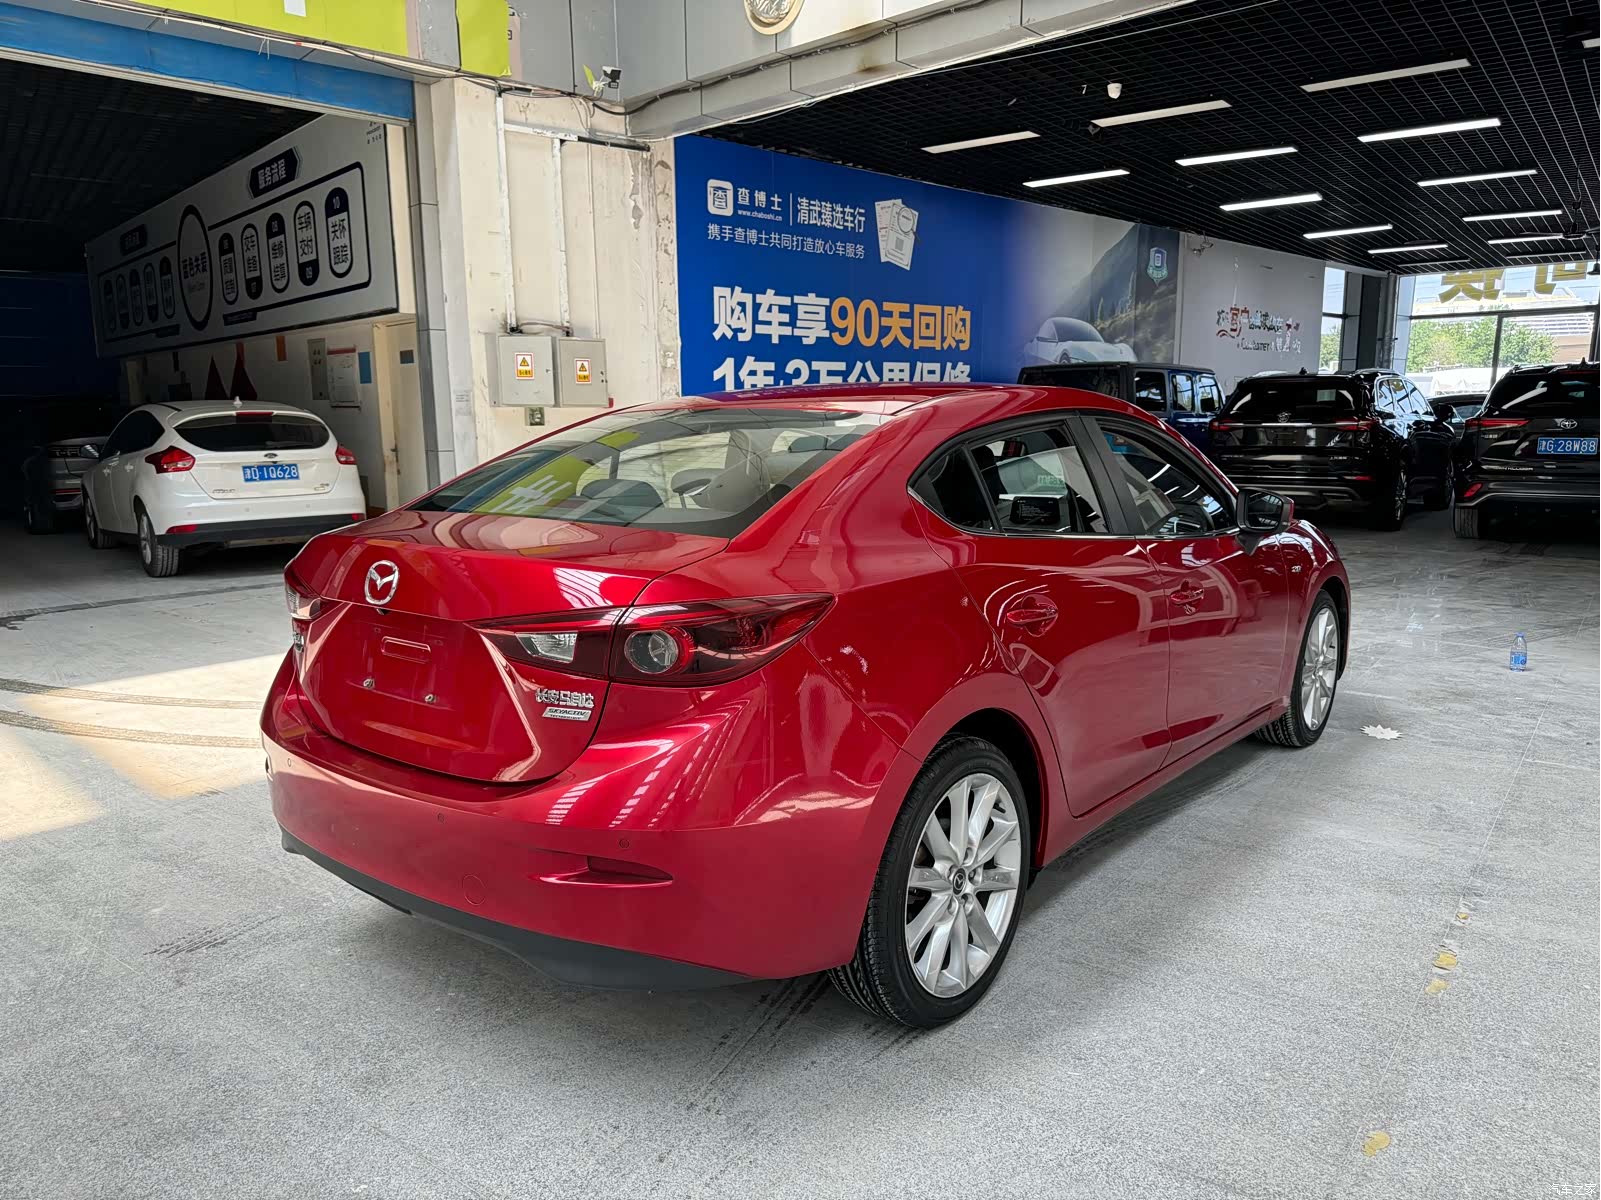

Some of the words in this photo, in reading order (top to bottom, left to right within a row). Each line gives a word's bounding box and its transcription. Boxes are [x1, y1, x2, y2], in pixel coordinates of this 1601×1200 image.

[737, 187, 783, 212] 查博士
[797, 197, 866, 233] 清武臻选车行
[737, 208, 783, 222] www.chaboshi.cn
[707, 222, 865, 260] 携手查博士共同打造放心车服务
[712, 285, 971, 351] 购车享90天回购
[535, 688, 594, 709] 长安马自达
[548, 708, 587, 716] SKYACTIV
